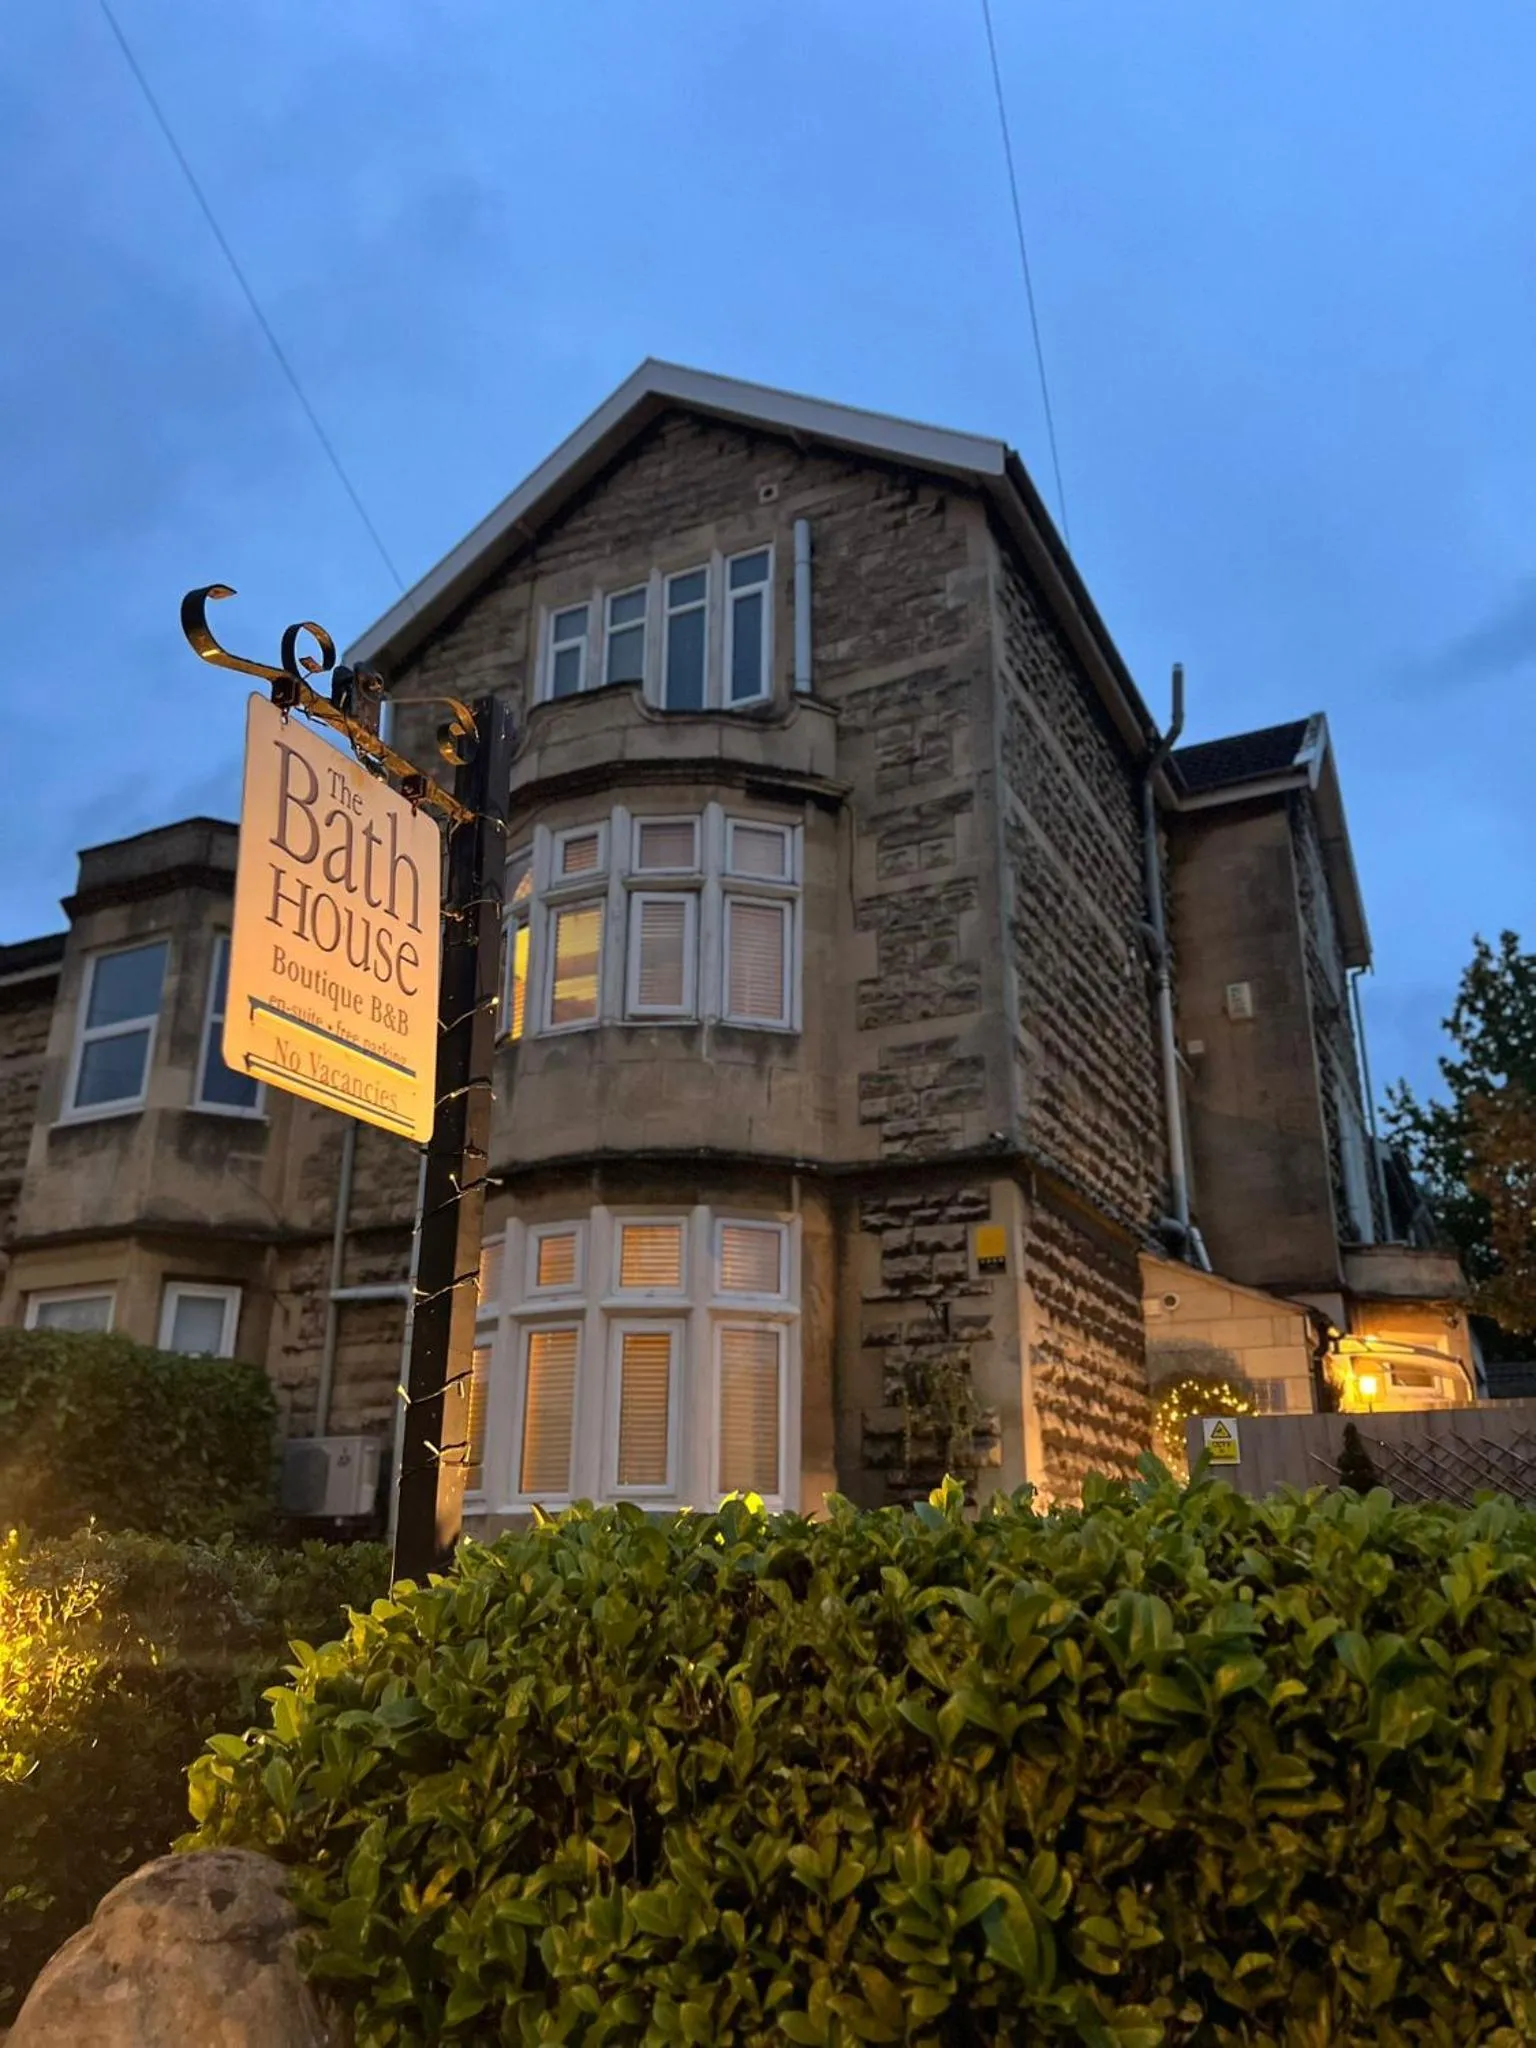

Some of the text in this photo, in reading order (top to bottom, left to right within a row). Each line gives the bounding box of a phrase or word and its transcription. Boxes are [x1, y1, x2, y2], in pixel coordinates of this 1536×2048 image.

[327, 767, 363, 816] The
[268, 740, 423, 935] Bath
[272, 944, 409, 1037] Boutique B&B
[274, 1036, 398, 1111] No Vacancies
